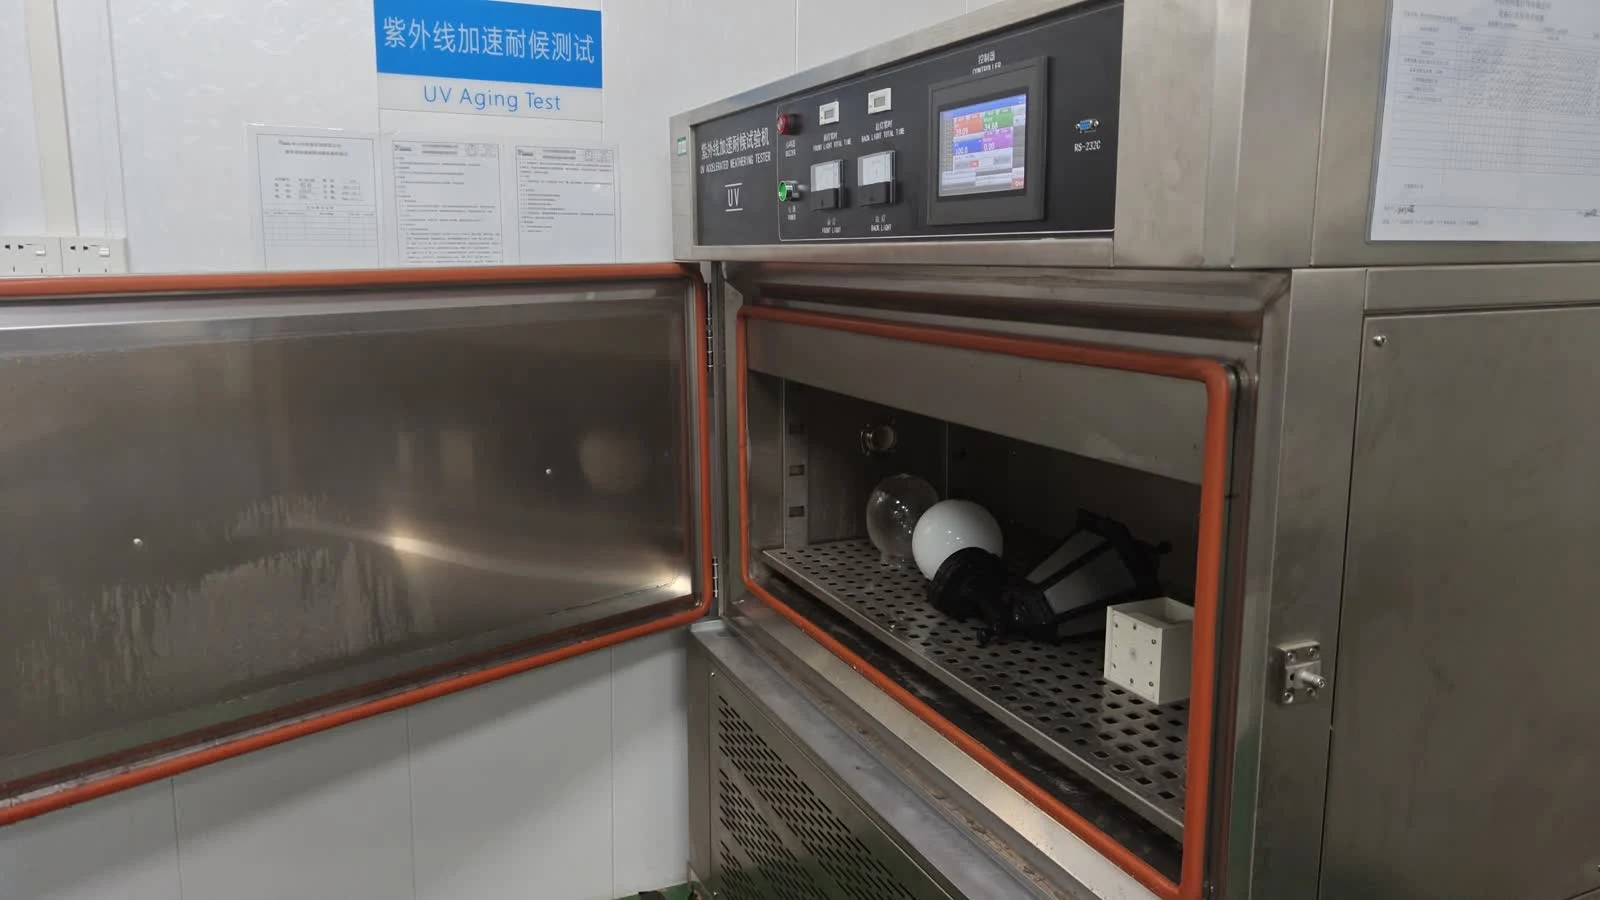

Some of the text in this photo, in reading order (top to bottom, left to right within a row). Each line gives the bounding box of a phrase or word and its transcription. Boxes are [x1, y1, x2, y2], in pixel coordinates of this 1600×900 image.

[383, 16, 595, 64] 紫外线加速耐候测试
[424, 85, 561, 112] UV Aging Test
[701, 127, 770, 160] 紫外线加速耐候试验机
[1074, 140, 1101, 152] RS-232C
[755, 151, 771, 164] TESTER
[727, 187, 740, 207] UV
[870, 223, 892, 232] BACK LIGHT
